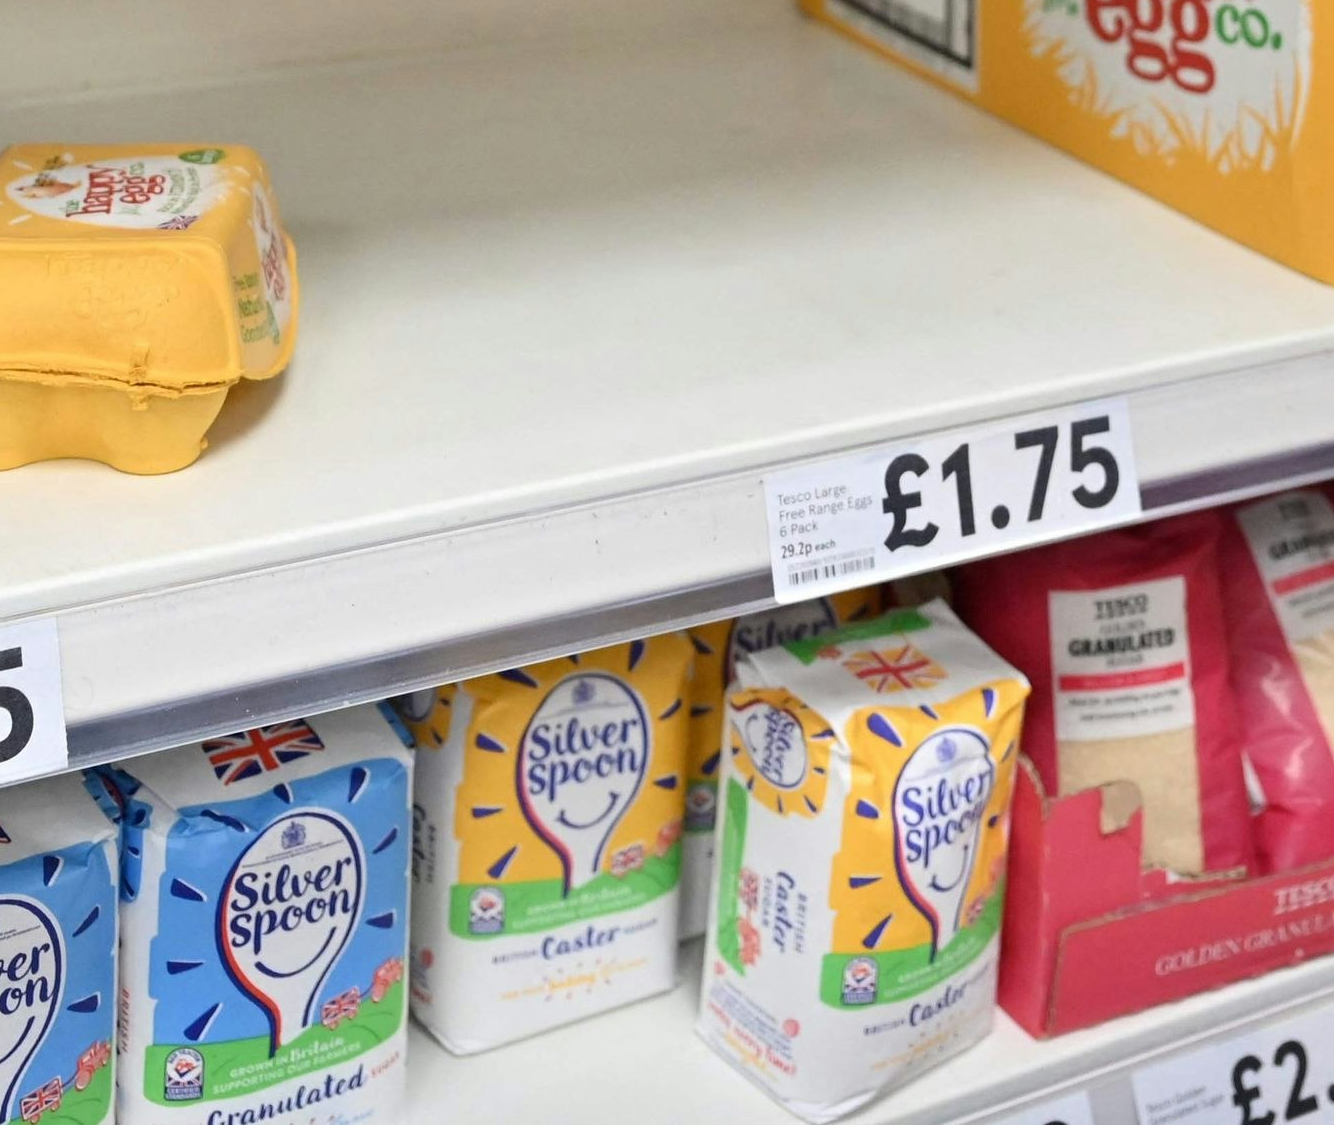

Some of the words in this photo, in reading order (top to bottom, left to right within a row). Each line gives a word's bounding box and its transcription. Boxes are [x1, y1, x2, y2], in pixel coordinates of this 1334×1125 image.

[1214, 4, 1283, 51] co.
[65, 164, 128, 218] happy
[778, 491, 812, 507] Tesco
[814, 485, 847, 500] Large
[882, 414, 1120, 554] £1.75
[778, 509, 806, 522] Free
[808, 501, 844, 516] Range
[847, 495, 873, 511] Eggs
[779, 525, 788, 538] 6
[790, 520, 819, 536] Pack
[781, 541, 813, 560] 29.2p
[815, 539, 837, 552] each
[1094, 593, 1149, 618] TESCO
[1067, 626, 1176, 658] GRANULATED
[528, 716, 640, 763] Silver
[528, 748, 641, 803] spoon
[900, 770, 994, 830] Silver
[230, 856, 353, 914] Silver
[229, 885, 355, 957] spoon
[541, 925, 621, 961] Caster
[1155, 940, 1243, 977] GOLDEN
[907, 980, 967, 1029] Caster
[212, 1068, 286, 1095] SUPPORTING
[287, 1060, 312, 1075] OUR
[229, 1058, 274, 1079] GROWN
[289, 1036, 345, 1063] Britain
[205, 1062, 365, 1125] Granulated
